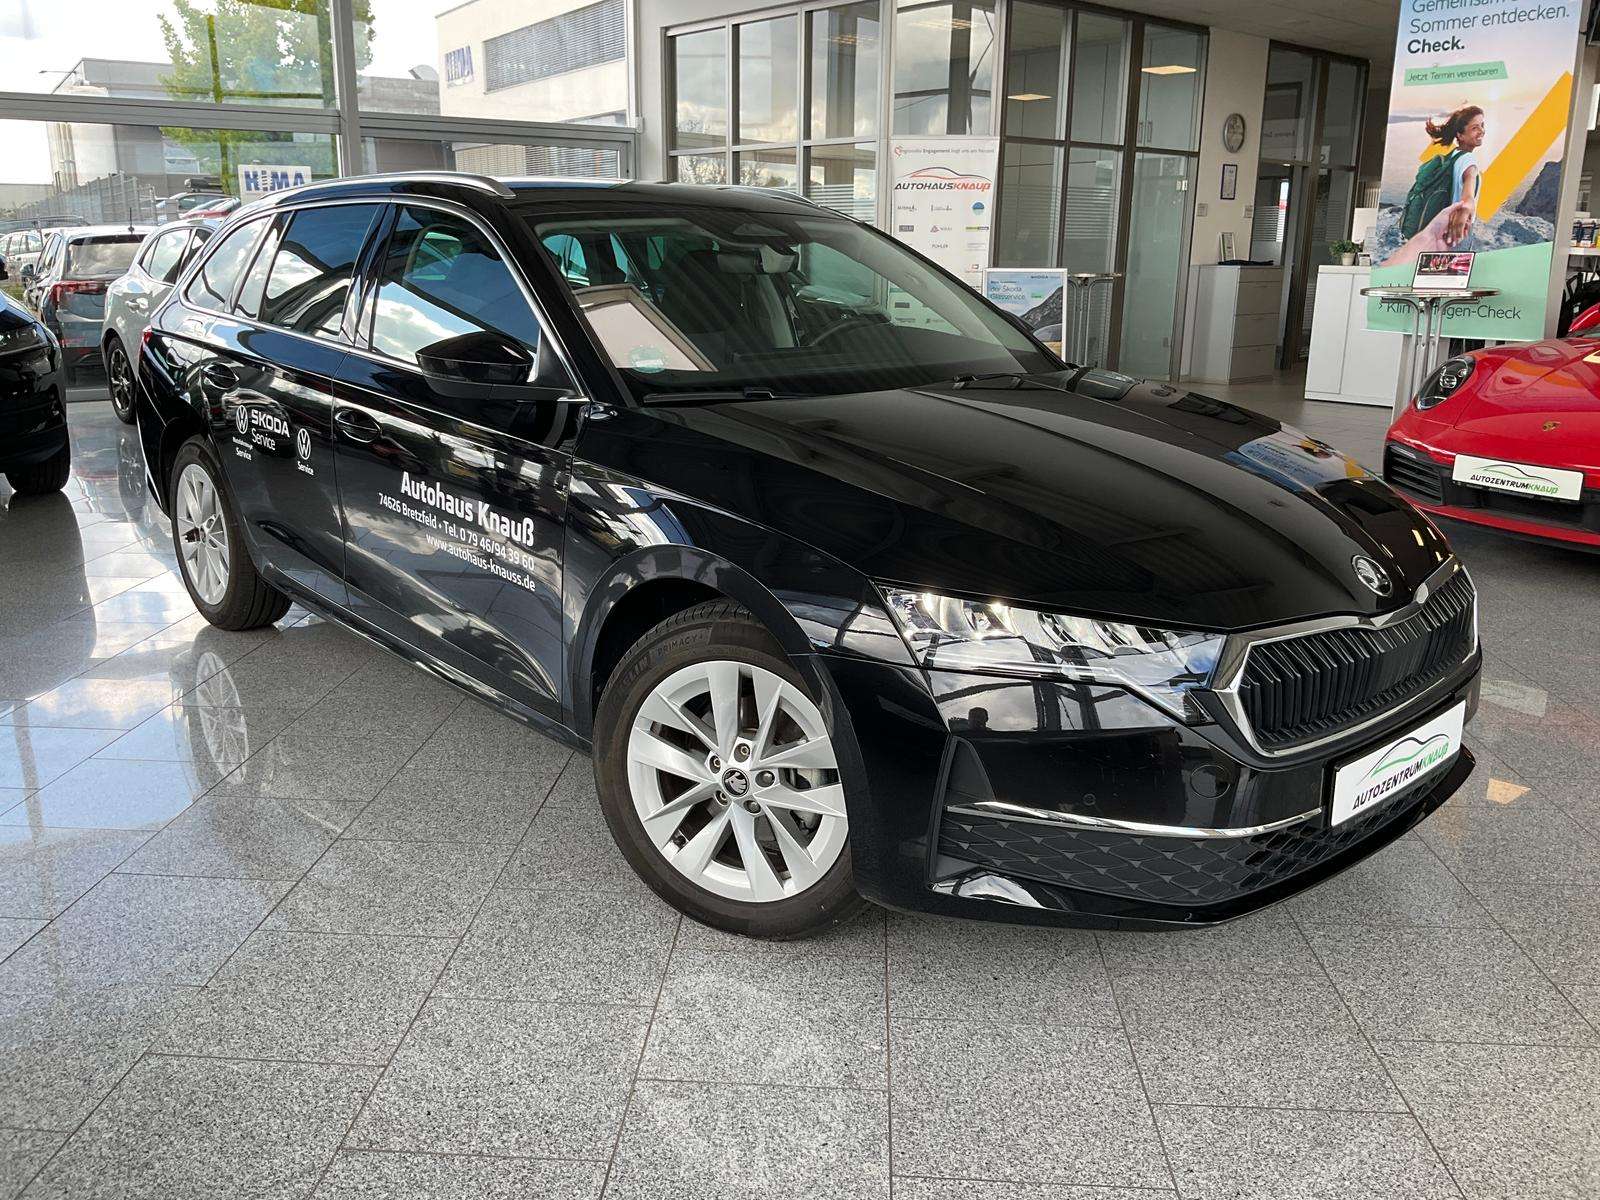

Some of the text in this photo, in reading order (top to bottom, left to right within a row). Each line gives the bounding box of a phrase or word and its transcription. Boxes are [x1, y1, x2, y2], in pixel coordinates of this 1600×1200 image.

[1410, 5, 1570, 34] Sommer entdecken.
[1407, 35, 1465, 54] Check.
[1408, 67, 1499, 82] Jetzt Termin vereinbaren
[244, 170, 305, 192] HIMA
[251, 427, 276, 451] Service
[401, 471, 535, 547] Autohaus Knauß
[379, 492, 535, 571] 74626 Bretzfeld Tel. 0 79 46/94 39 60
[426, 533, 536, 592] www.autohaus-knauss.de
